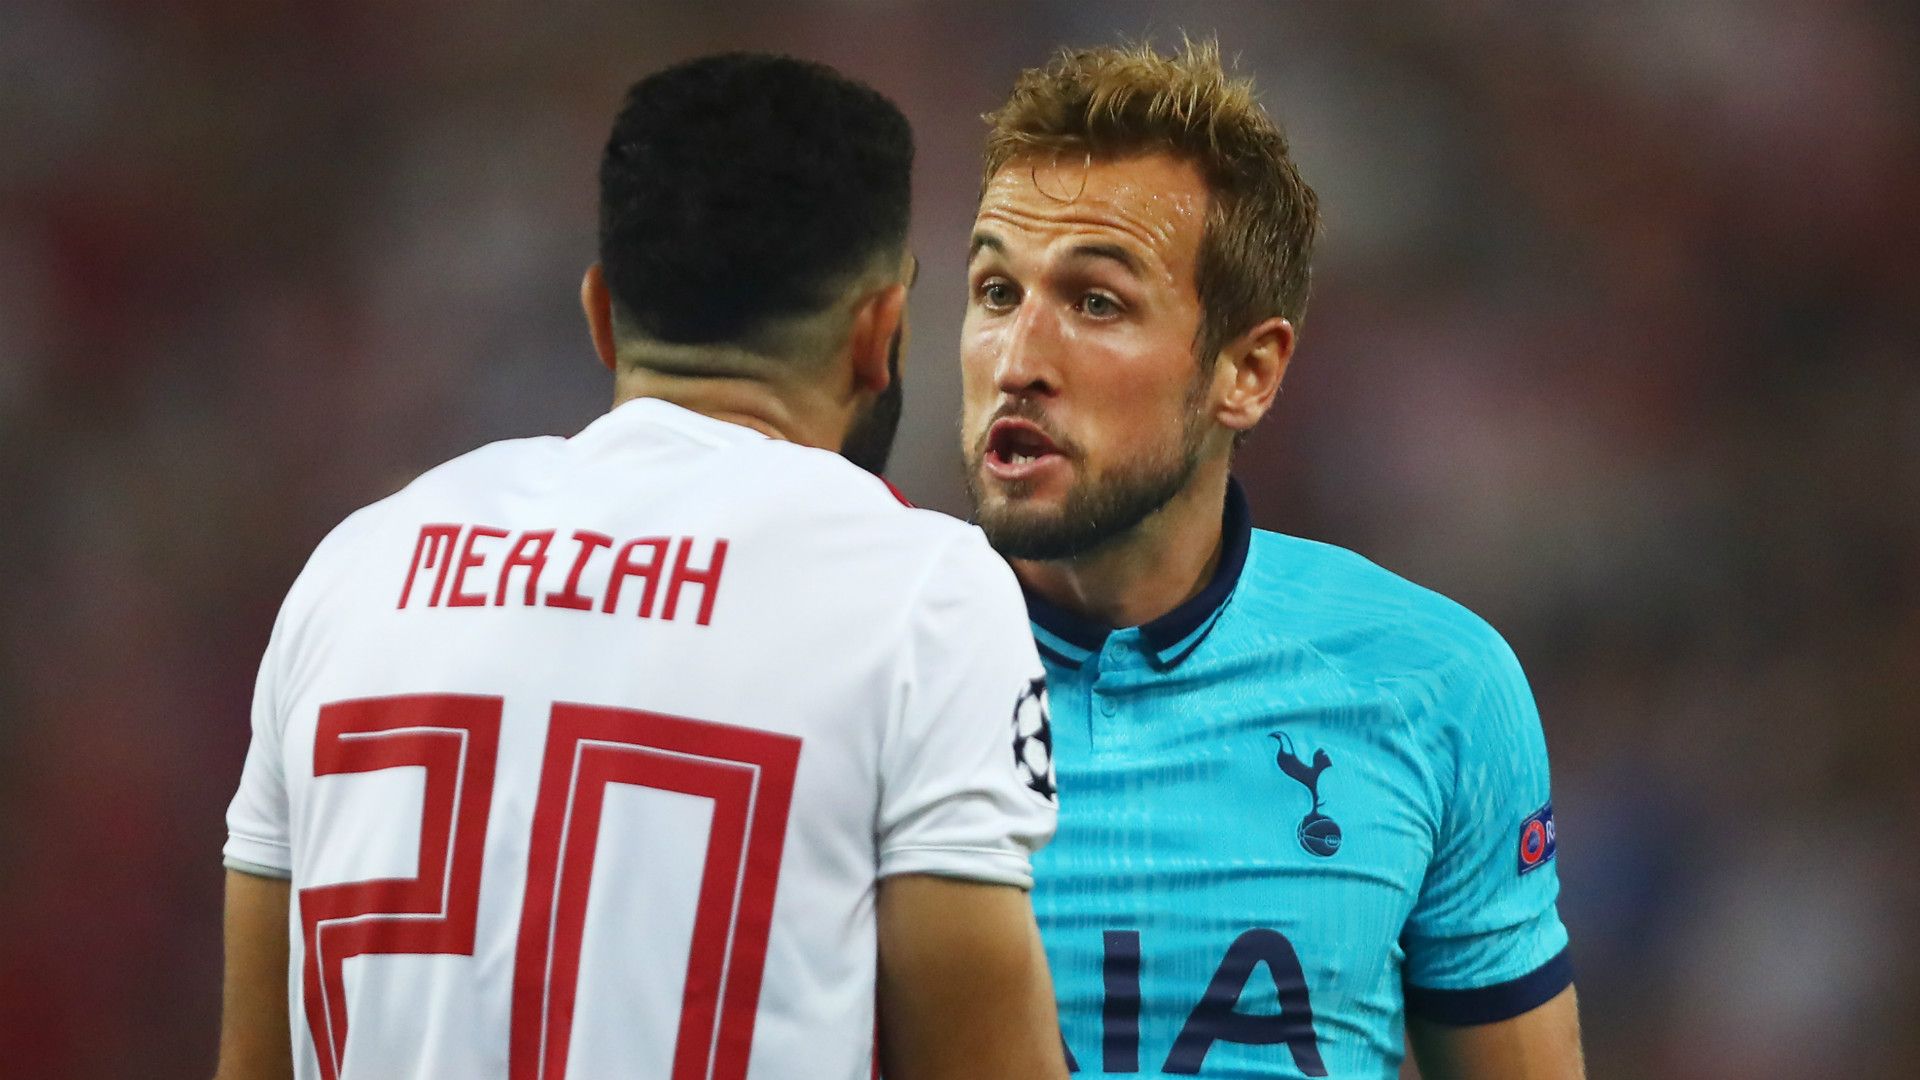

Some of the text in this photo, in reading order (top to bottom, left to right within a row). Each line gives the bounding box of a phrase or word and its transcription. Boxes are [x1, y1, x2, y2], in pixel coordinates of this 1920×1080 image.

[397, 523, 729, 626] MERIAH
[299, 692, 803, 1080] 20
[1059, 927, 1328, 1077] IA
